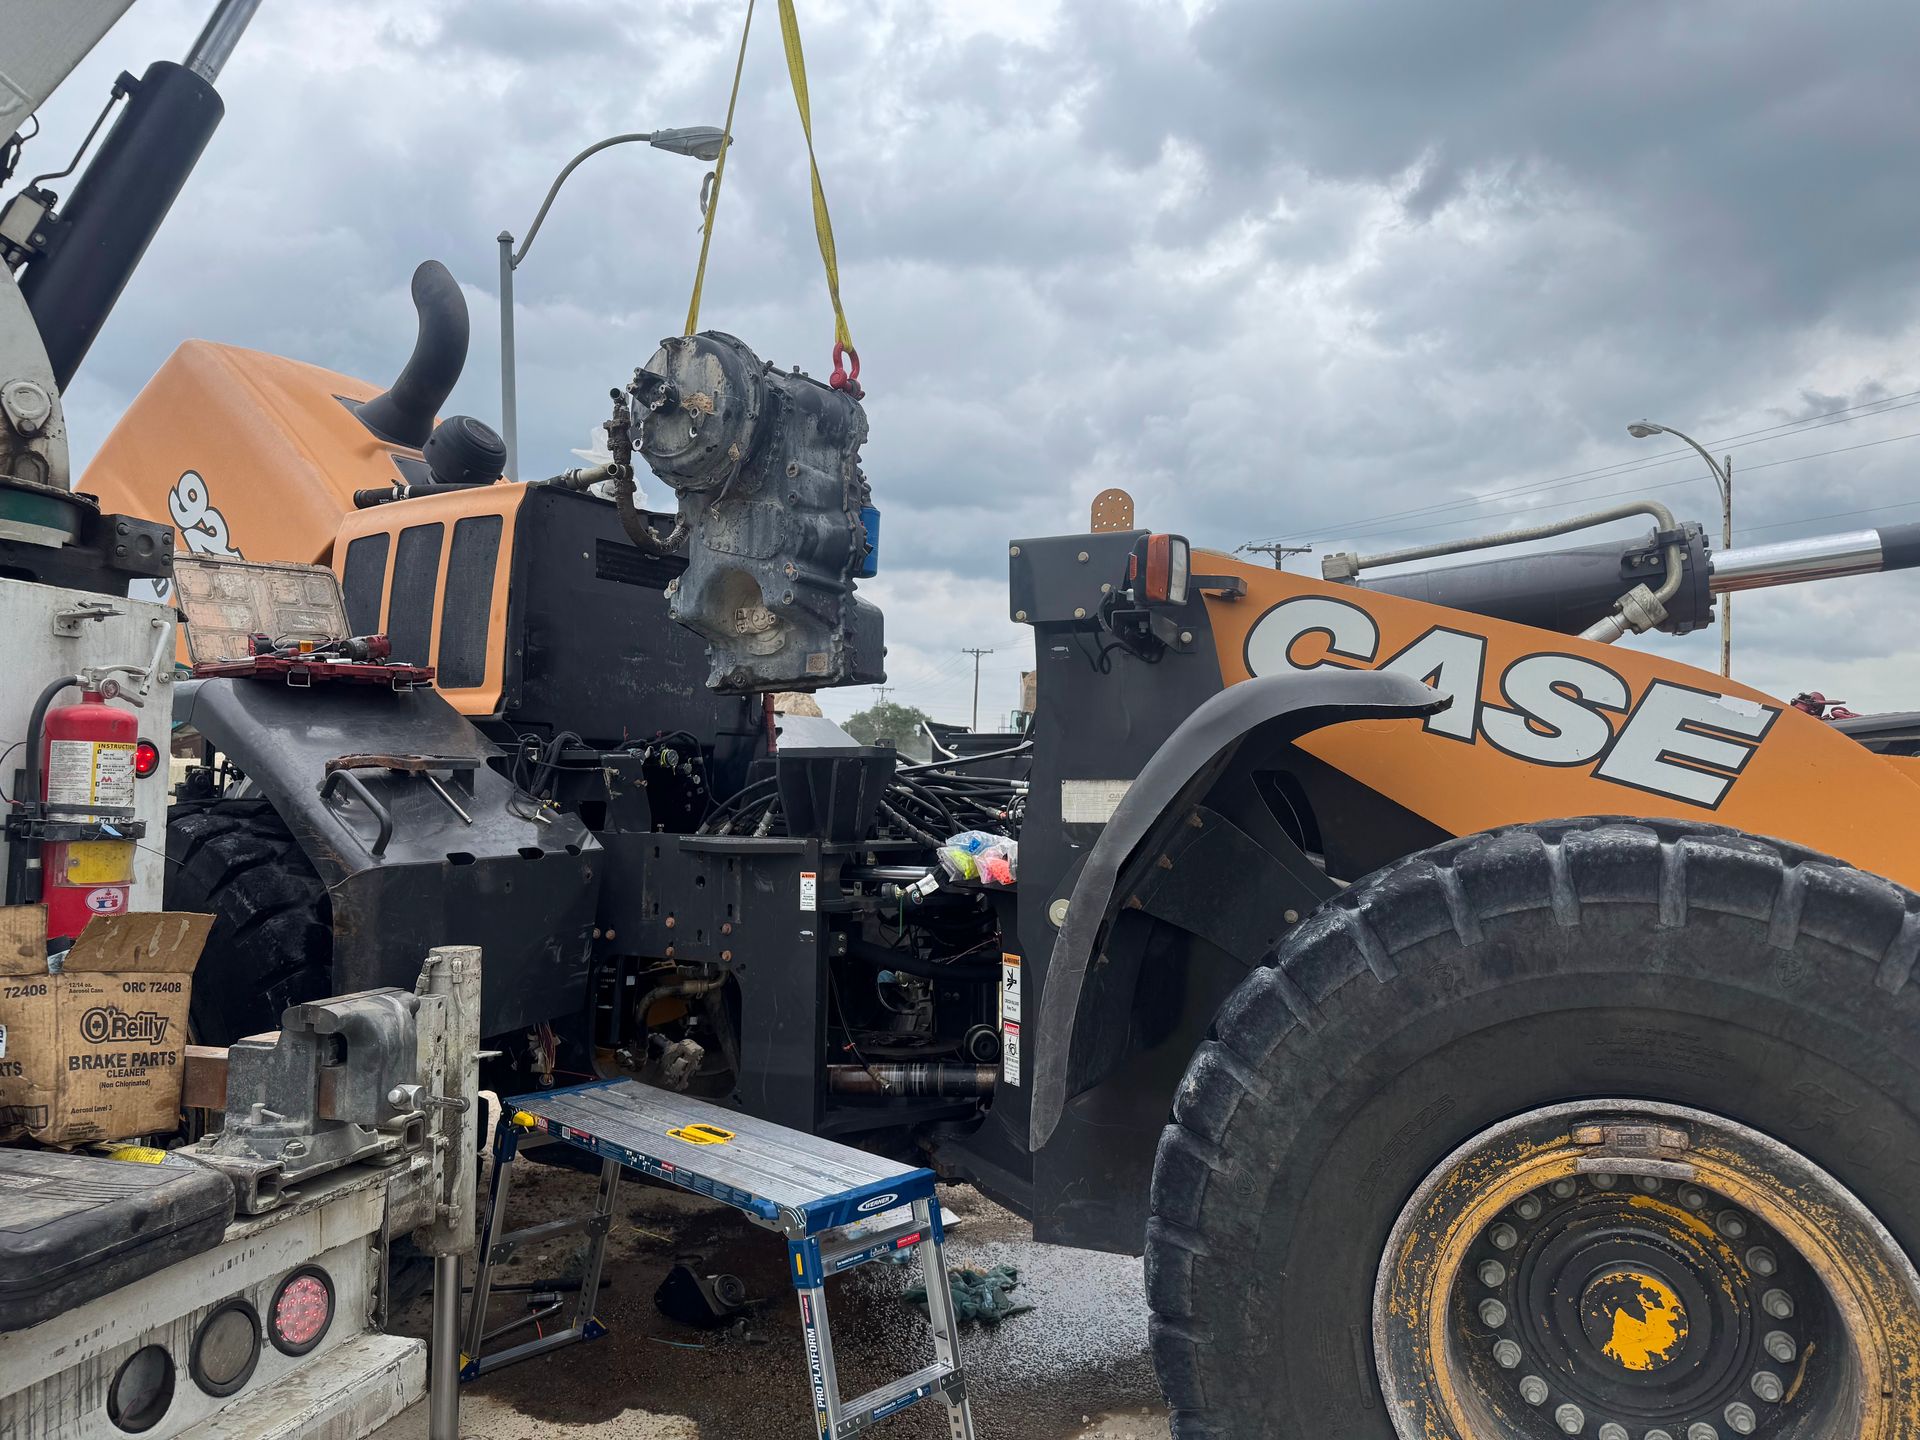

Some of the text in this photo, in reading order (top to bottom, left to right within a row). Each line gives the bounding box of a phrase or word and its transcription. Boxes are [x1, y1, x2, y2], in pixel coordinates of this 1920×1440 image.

[168, 469, 245, 561] 92
[1243, 594, 1783, 811] CASE
[4, 984, 48, 999] 72408
[122, 981, 182, 993] ORC 72408
[80, 1006, 169, 1045] O'Reilly
[68, 1051, 177, 1071] BRAKE PARTS
[106, 1068, 146, 1079] CLEANER
[99, 1079, 151, 1089] (Non Chlorinated)
[70, 1104, 113, 1115] Aerosol Level 3
[865, 1196, 890, 1209] WERNER
[806, 1328, 824, 1386] PLATFORM
[815, 1387, 826, 1408] PRO
